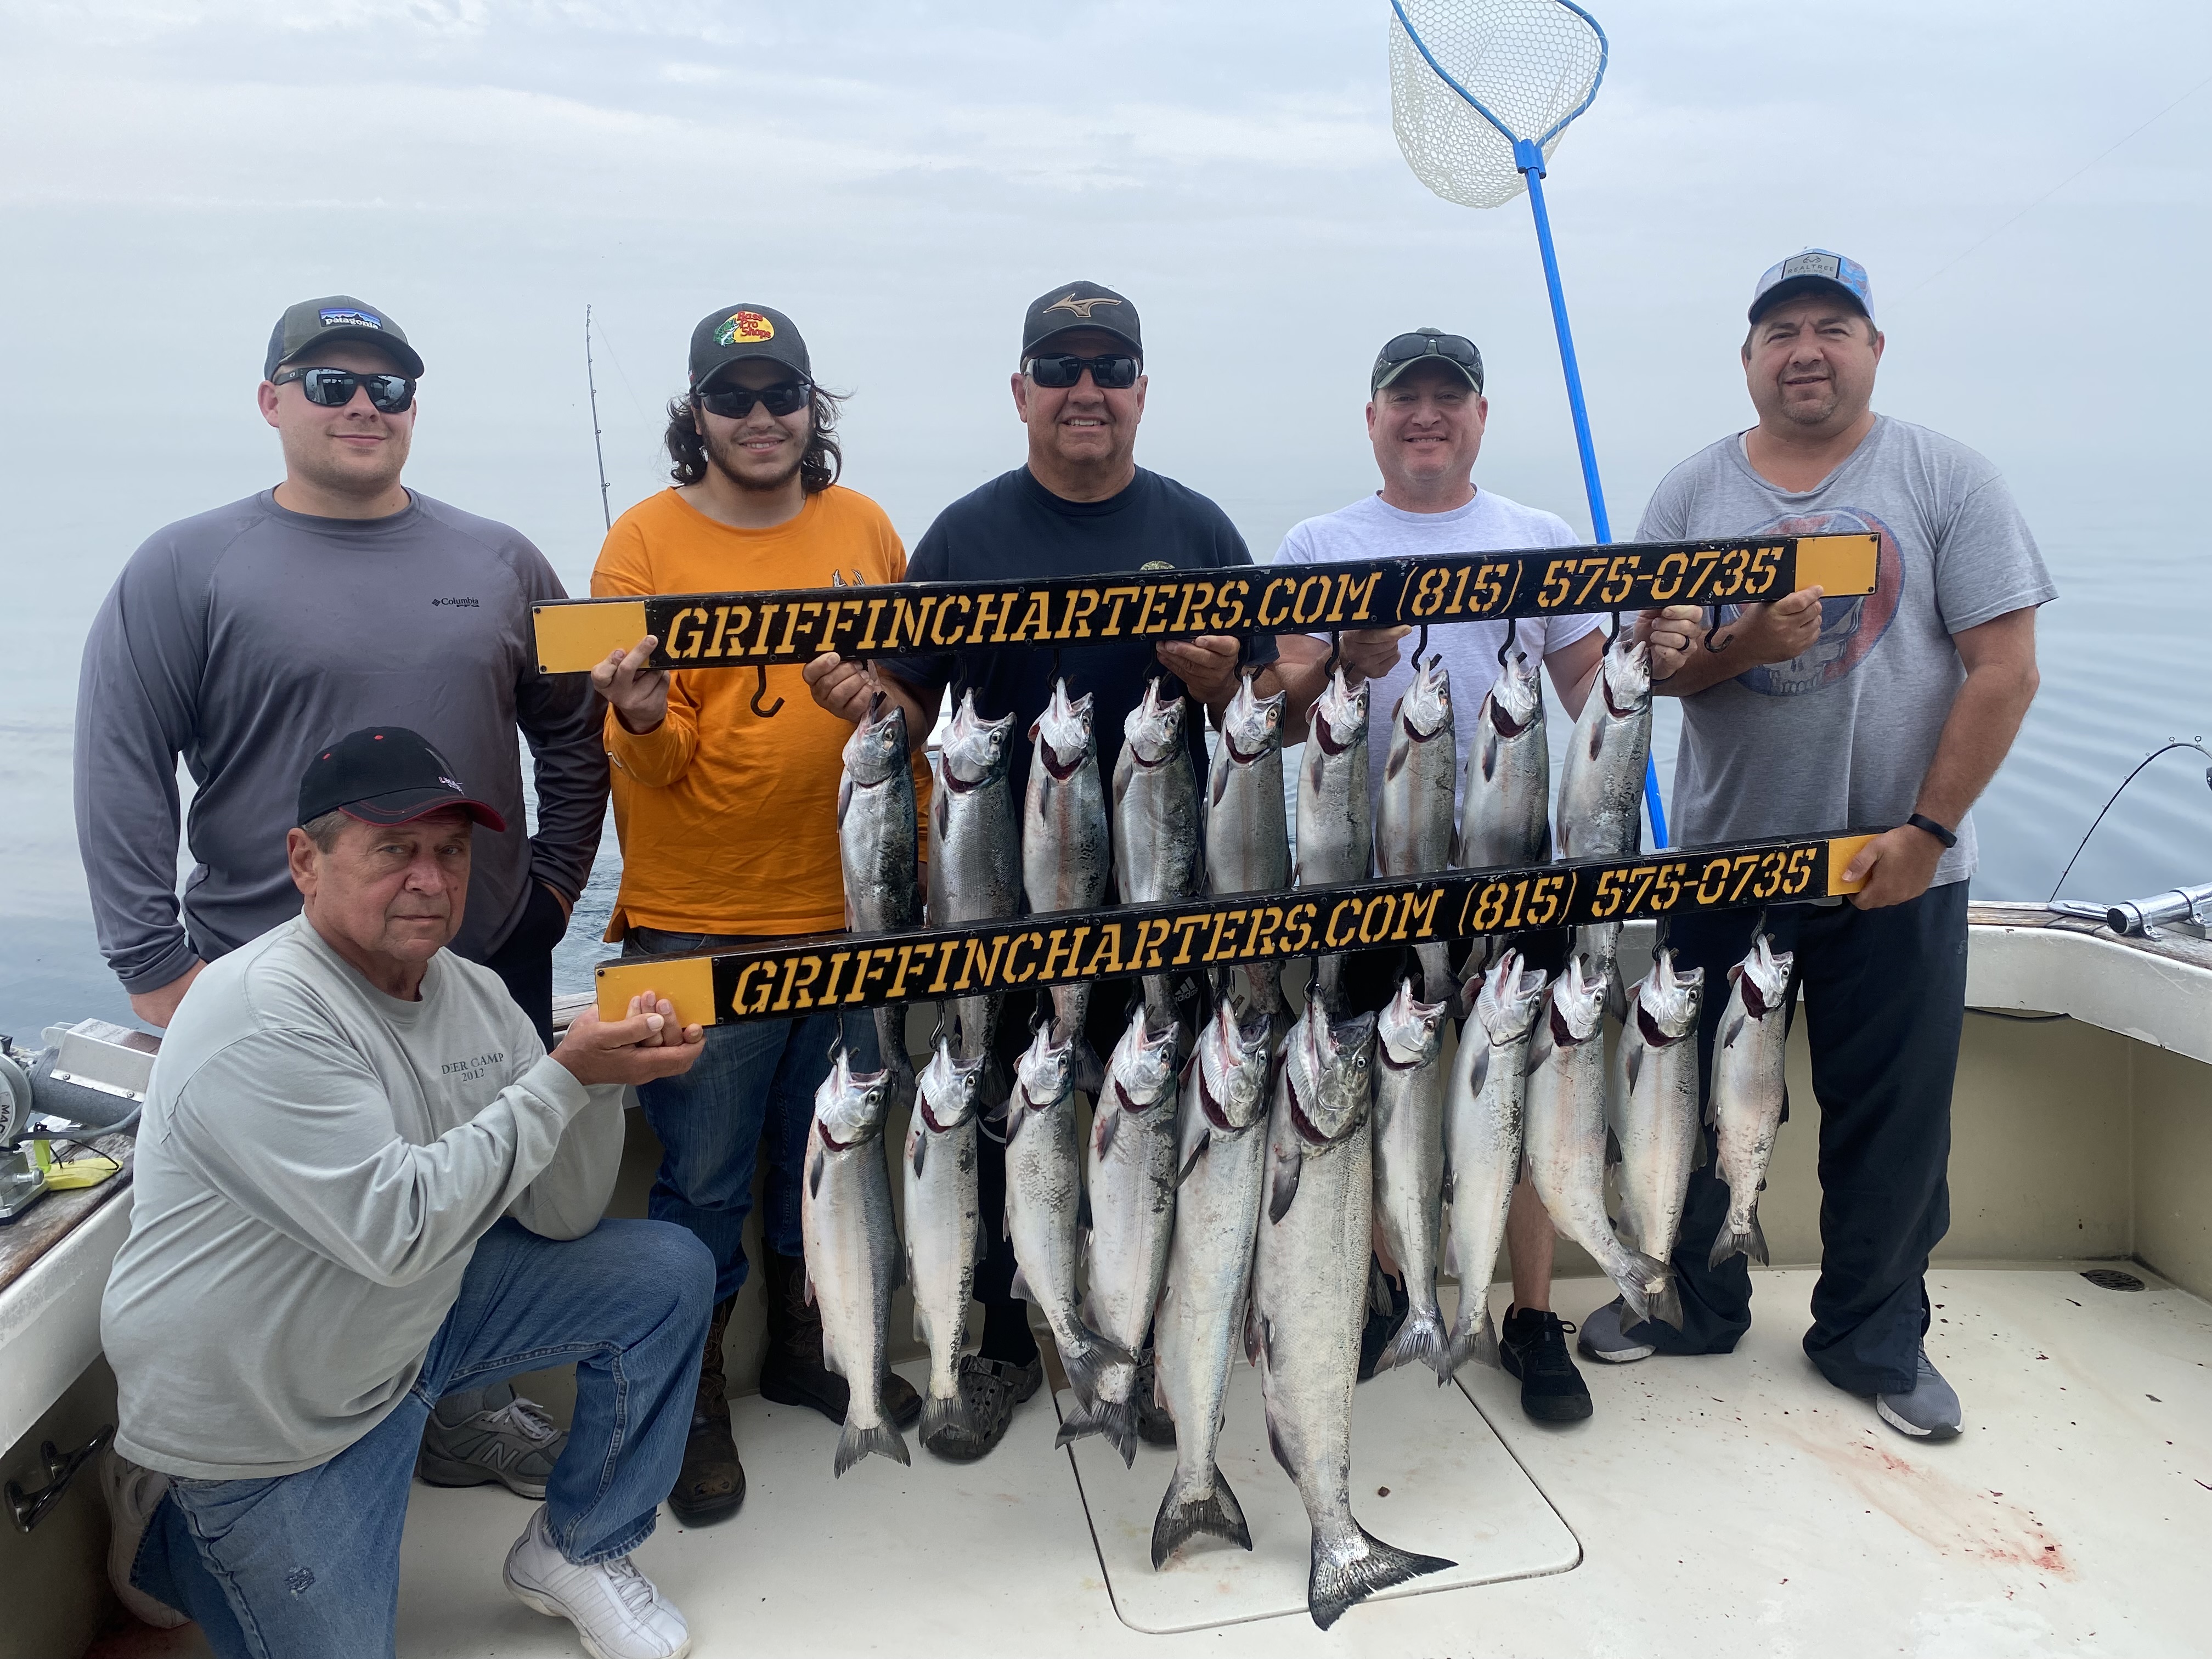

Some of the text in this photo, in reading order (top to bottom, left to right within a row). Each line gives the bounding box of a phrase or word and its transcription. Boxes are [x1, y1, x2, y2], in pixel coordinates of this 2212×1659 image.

[1787, 264, 1835, 274] REALTREE
[737, 311, 763, 321] Bass
[325, 318, 379, 330] patagonia
[740, 318, 758, 329] Pro
[740, 327, 771, 338] Shops
[441, 596, 479, 605] Columbia
[665, 547, 1783, 659] GRIFFINCHARTERS.COM (815) 575-0735
[732, 848, 1817, 1014] GRIFFINCHARTERS.COM (815) 575-0735
[471, 1053, 504, 1068] CAMP
[461, 1068, 484, 1082] 2012
